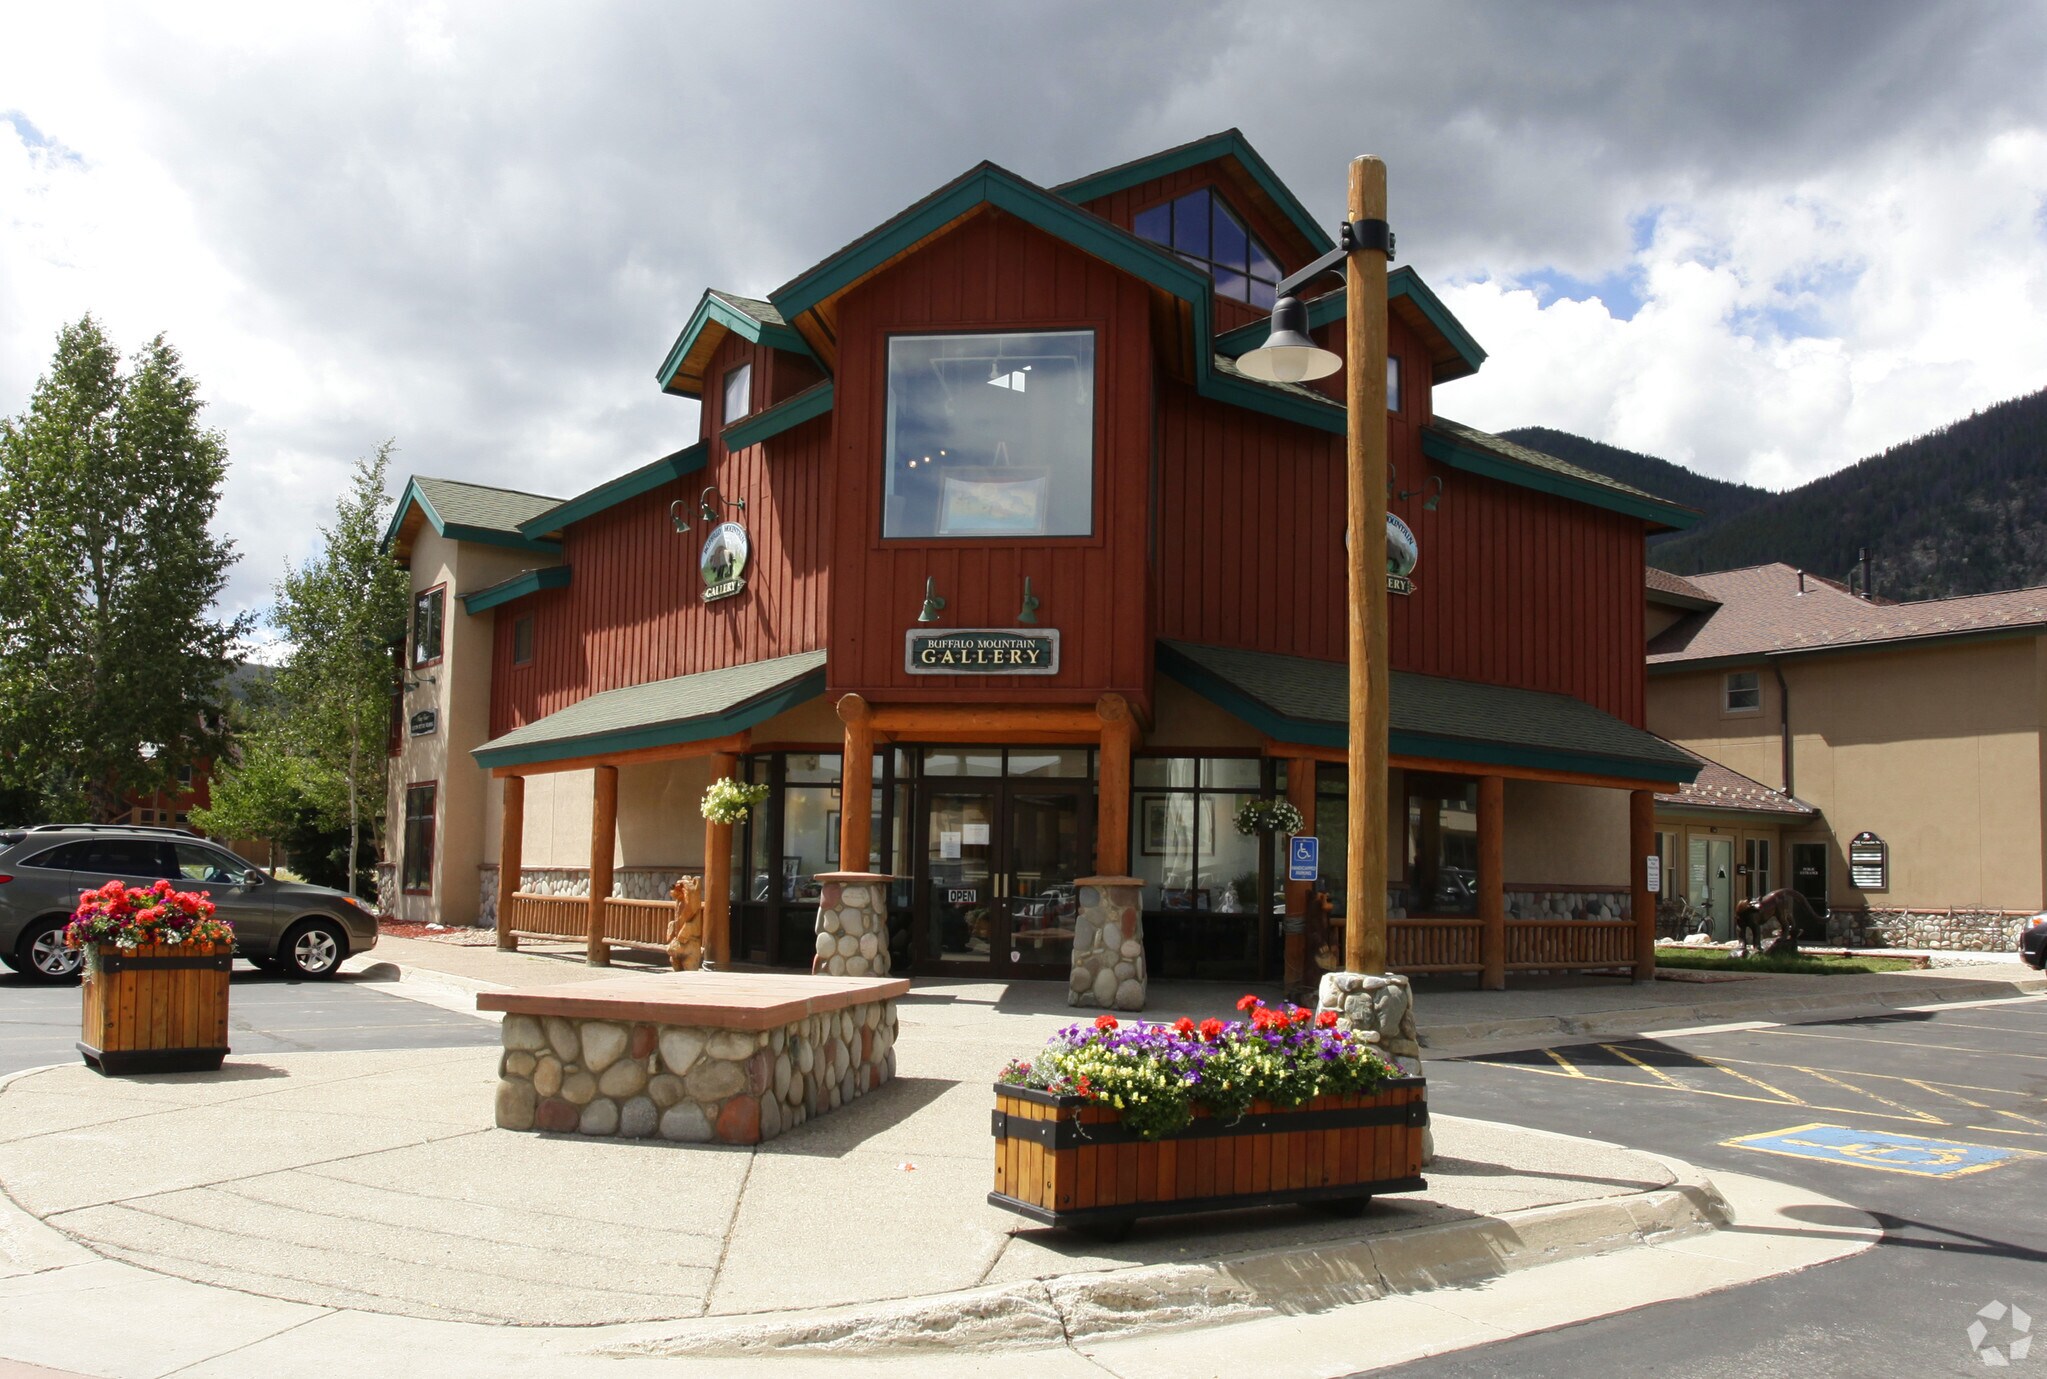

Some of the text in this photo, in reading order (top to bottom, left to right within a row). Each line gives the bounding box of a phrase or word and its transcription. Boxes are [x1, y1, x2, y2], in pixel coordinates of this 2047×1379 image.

[705, 581, 736, 598] GALLERY
[927, 640, 1036, 649] BUFFALO MOUNTAIN
[950, 890, 975, 903] OPEN
